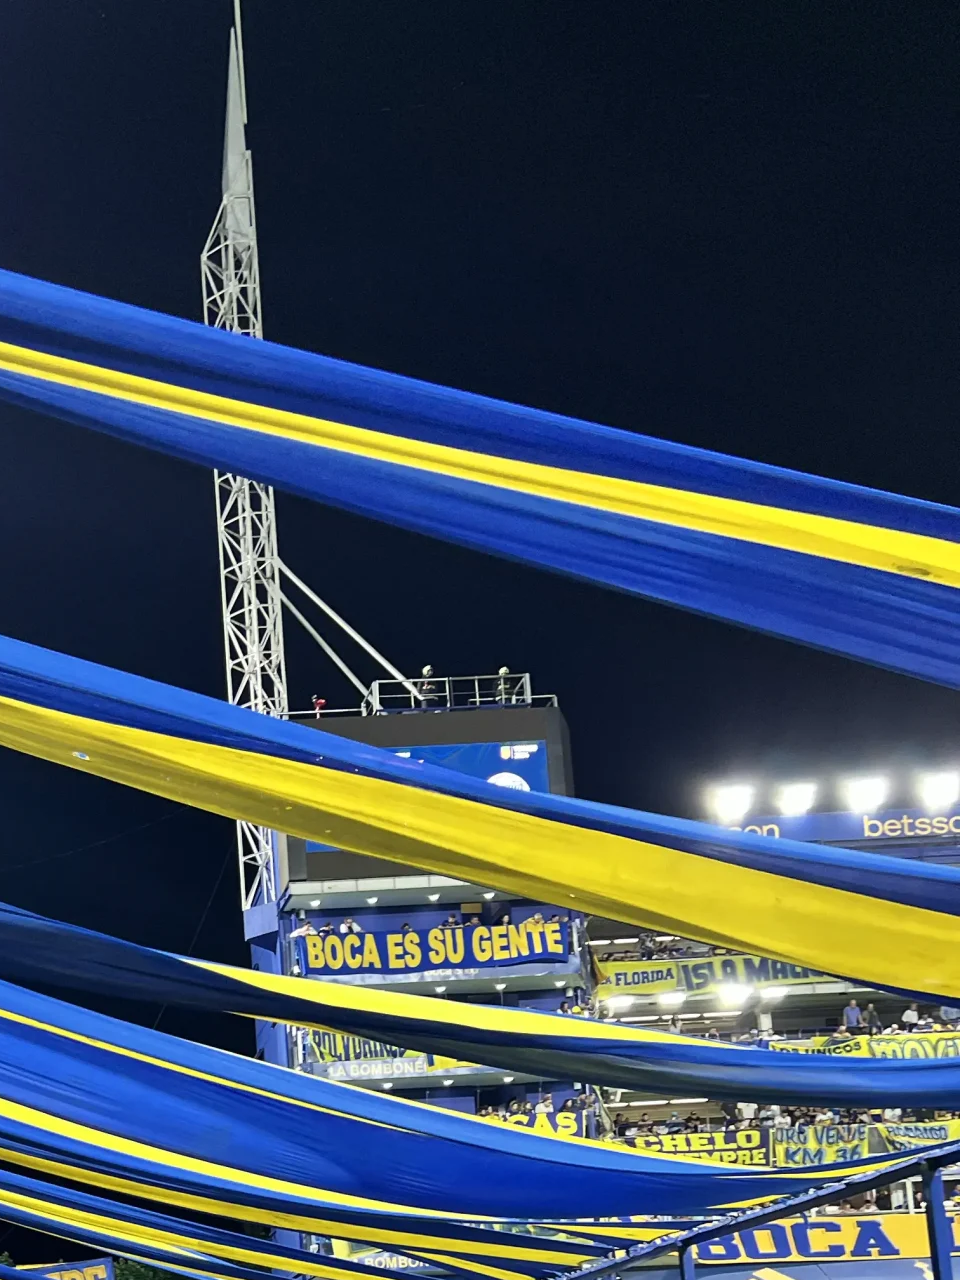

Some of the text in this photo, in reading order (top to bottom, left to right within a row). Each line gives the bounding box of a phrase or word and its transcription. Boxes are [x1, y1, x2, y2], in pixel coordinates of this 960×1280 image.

[306, 922, 564, 969] BOCA ES SU GENTE
[615, 968, 675, 986] FLORIDA
[351, 1061, 428, 1076] BOMBONE
[785, 1145, 862, 1165] KM 36
